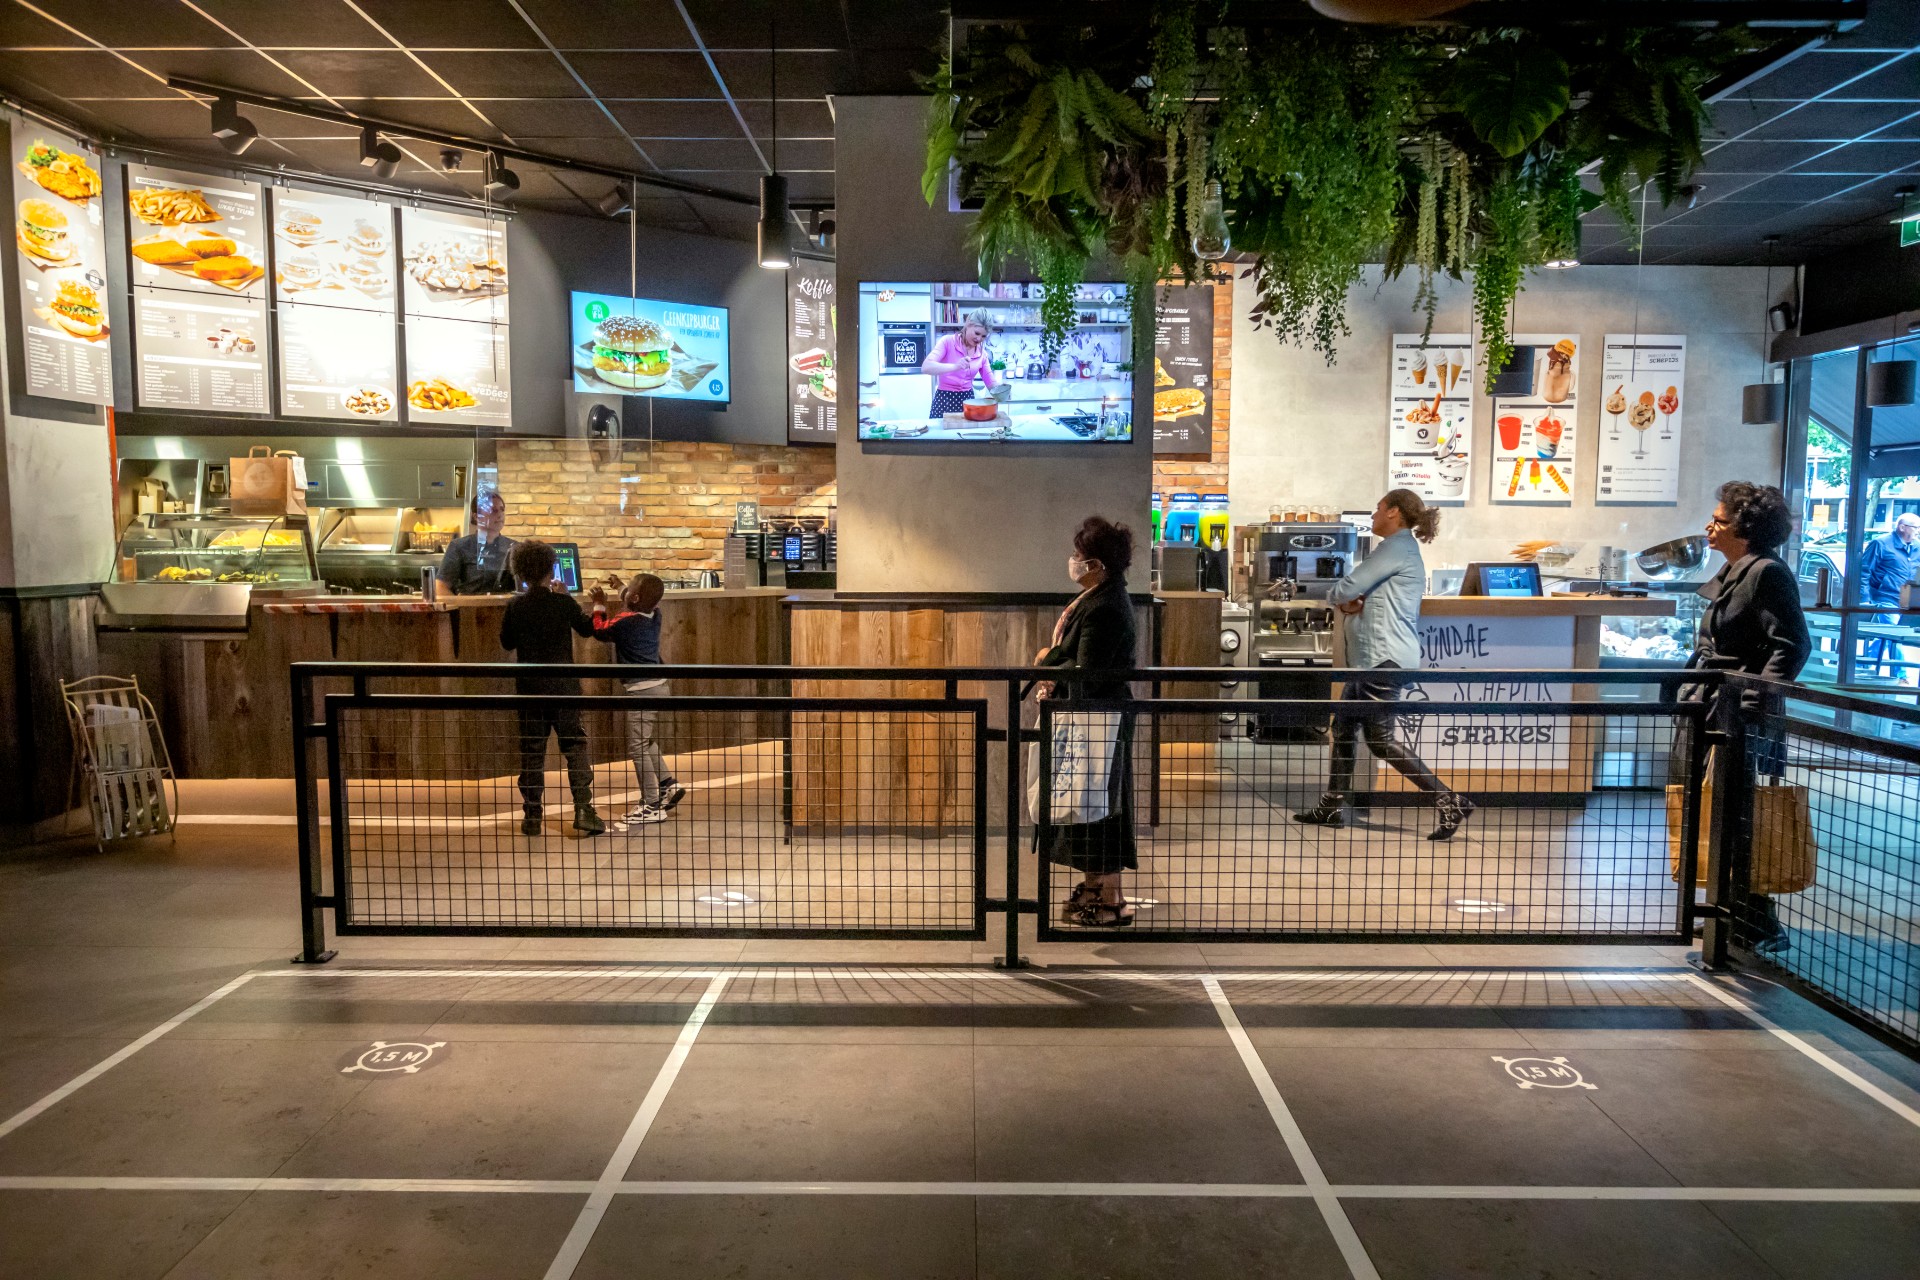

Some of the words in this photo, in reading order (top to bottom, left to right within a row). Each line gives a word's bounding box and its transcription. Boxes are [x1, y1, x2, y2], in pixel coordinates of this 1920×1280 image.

[797, 278, 835, 299] Koffie
[878, 289, 896, 302] MAX
[663, 310, 721, 331] GEENKIPBURGER
[370, 1051, 401, 1064] 1,5
[400, 1051, 424, 1062] M
[1515, 1066, 1548, 1079] 1,5
[1549, 1066, 1572, 1078] M
